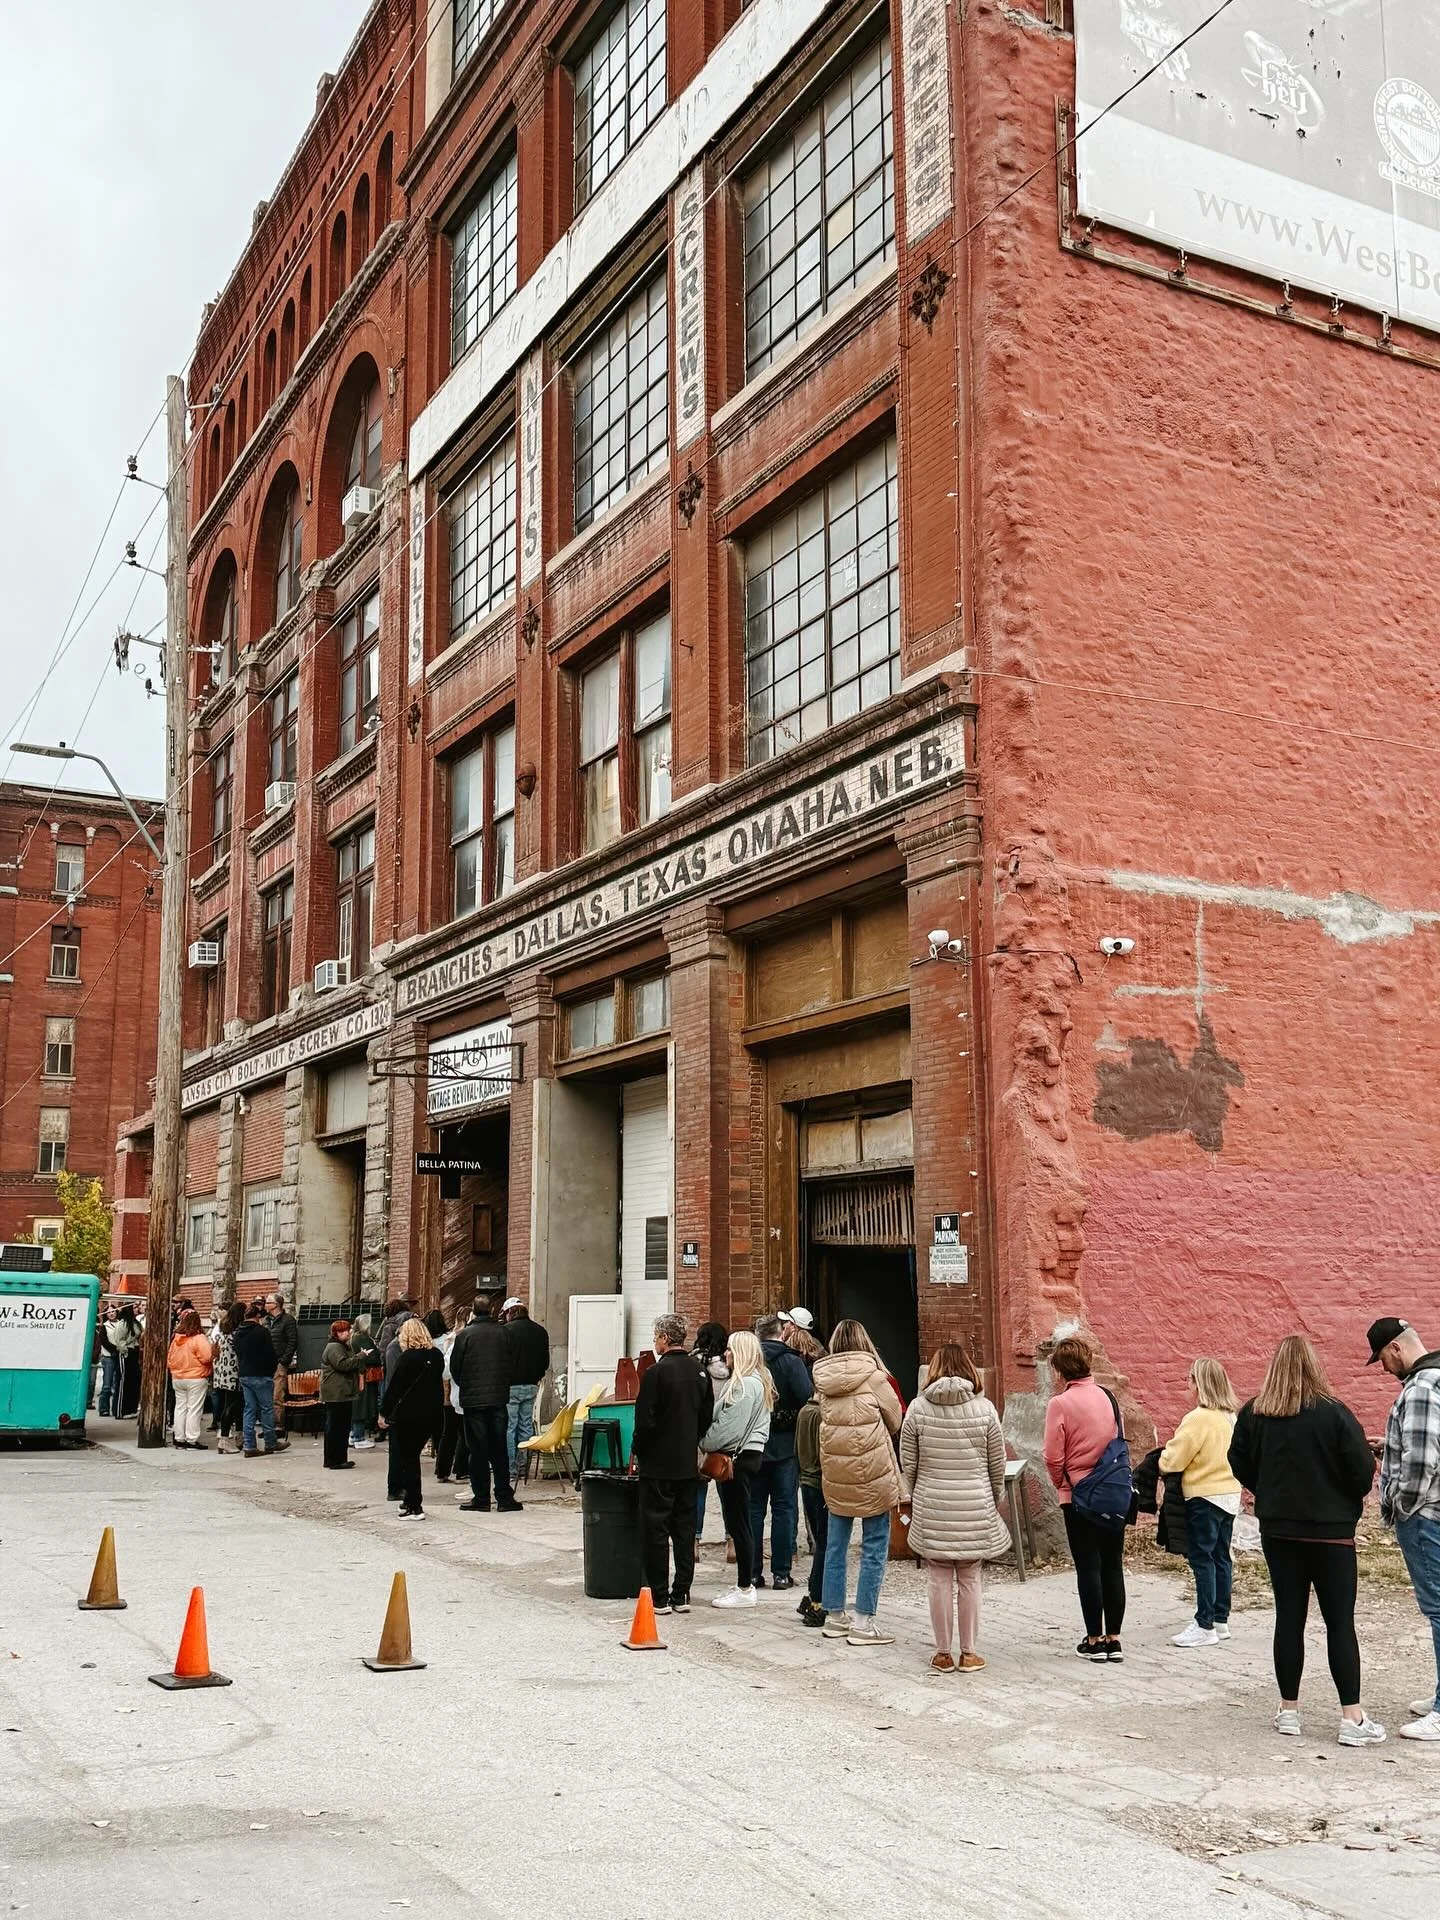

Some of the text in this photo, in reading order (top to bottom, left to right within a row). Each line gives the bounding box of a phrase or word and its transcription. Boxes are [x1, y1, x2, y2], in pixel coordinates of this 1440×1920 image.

[680, 191, 700, 420] SCREWS
[525, 372, 538, 559] NUTS
[411, 505, 423, 662] BOLTS
[182, 1081, 212, 1104] ANSAS
[215, 1068, 234, 1090] CITY
[288, 1042, 295, 1062] &
[300, 1023, 339, 1056] SCREW
[428, 1088, 451, 1112] VINTAGE
[419, 1160, 481, 1170] BELLA PATINA
[935, 1231, 958, 1244] PARKING
[941, 1217, 951, 1229] NO
